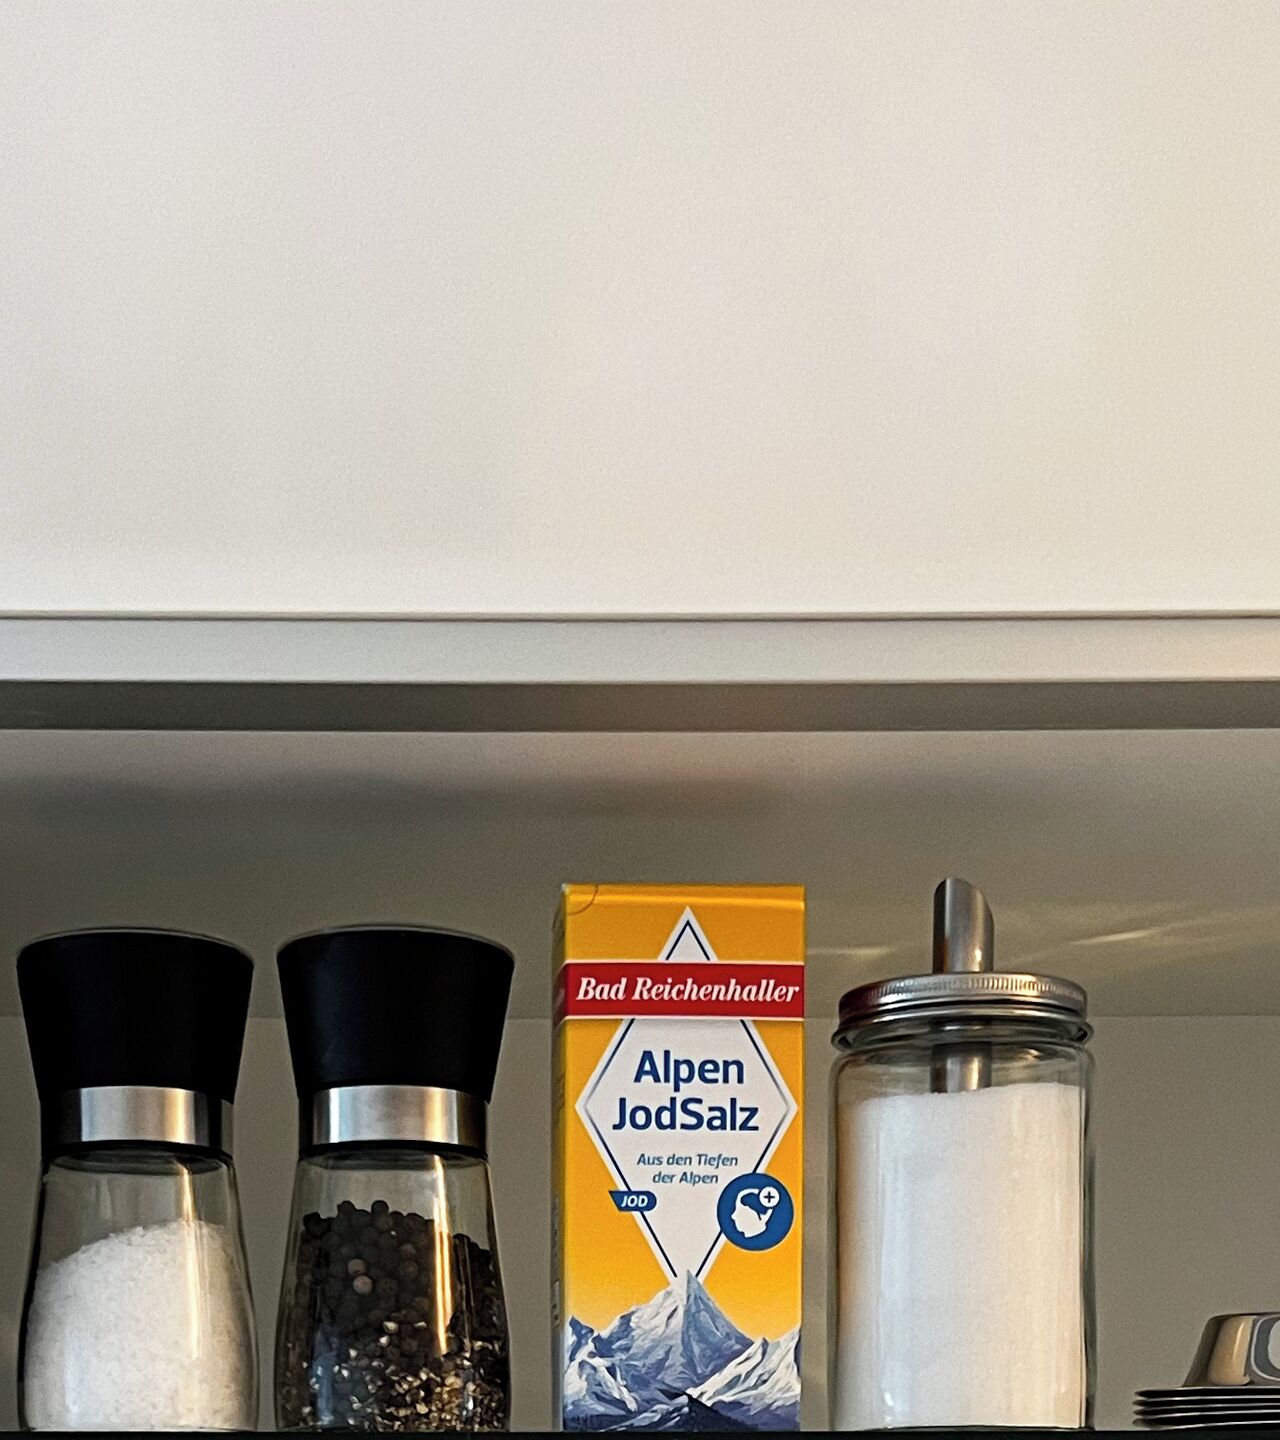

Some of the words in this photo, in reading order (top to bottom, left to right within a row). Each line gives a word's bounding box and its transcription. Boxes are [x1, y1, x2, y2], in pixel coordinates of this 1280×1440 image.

[576, 977, 628, 1001] Bad
[631, 977, 800, 1003] Reichenhaller
[633, 1050, 744, 1092] Alpen
[612, 1097, 759, 1131] JodSalz
[637, 1153, 663, 1166] Aus
[666, 1153, 693, 1166] den
[697, 1153, 738, 1169] Tiefen
[652, 1172, 675, 1184] der
[679, 1172, 719, 1187] Alpen
[620, 1195, 648, 1208] JOD
